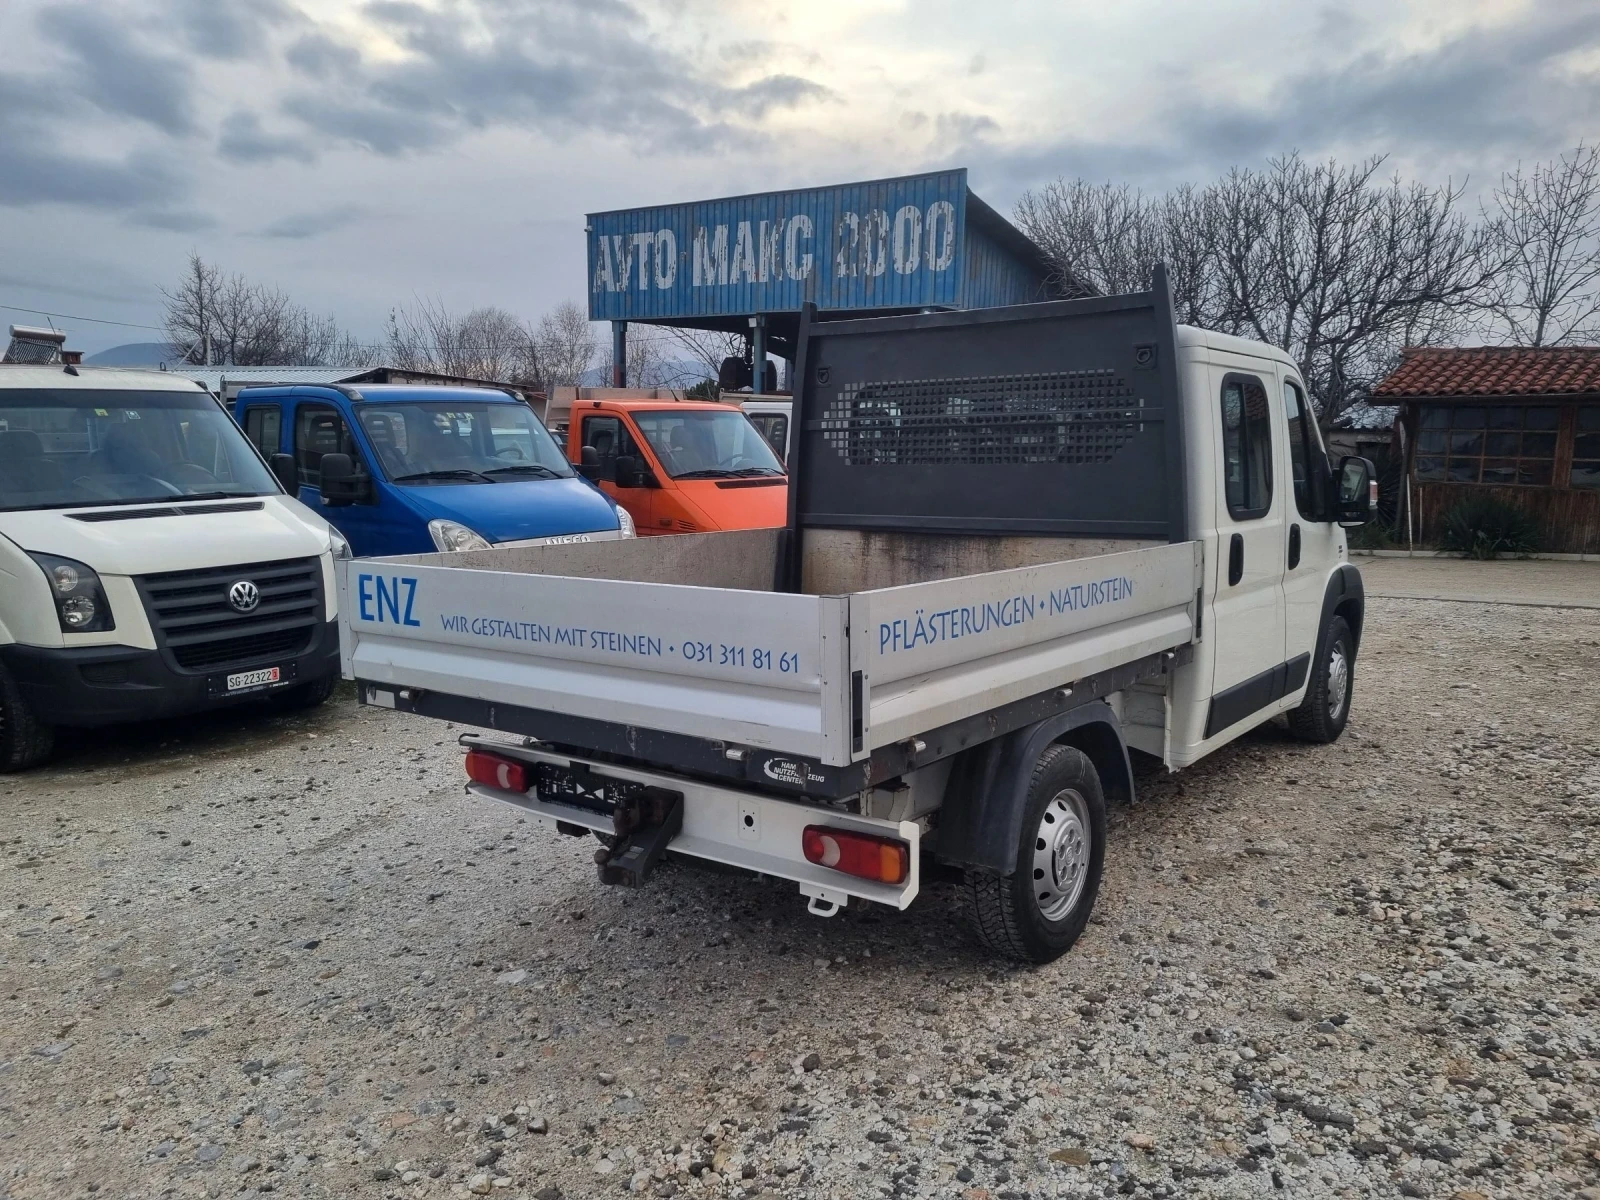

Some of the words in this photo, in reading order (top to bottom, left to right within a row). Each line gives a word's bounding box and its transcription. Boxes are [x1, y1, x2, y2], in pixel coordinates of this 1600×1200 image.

[693, 215, 813, 286] МАКС
[837, 201, 954, 277] 2000
[358, 574, 421, 627] ENZ
[880, 595, 1034, 654] PFLÄSTERUNGEN
[1050, 576, 1133, 616] NATURSTEIN
[440, 614, 469, 633] WIR
[471, 617, 551, 643] GESTALTEN
[555, 627, 588, 647] MIT
[591, 631, 661, 657] STEINEN
[682, 641, 712, 663] 031
[719, 644, 745, 667] 311
[752, 648, 772, 670] 81
[779, 651, 799, 674] 61
